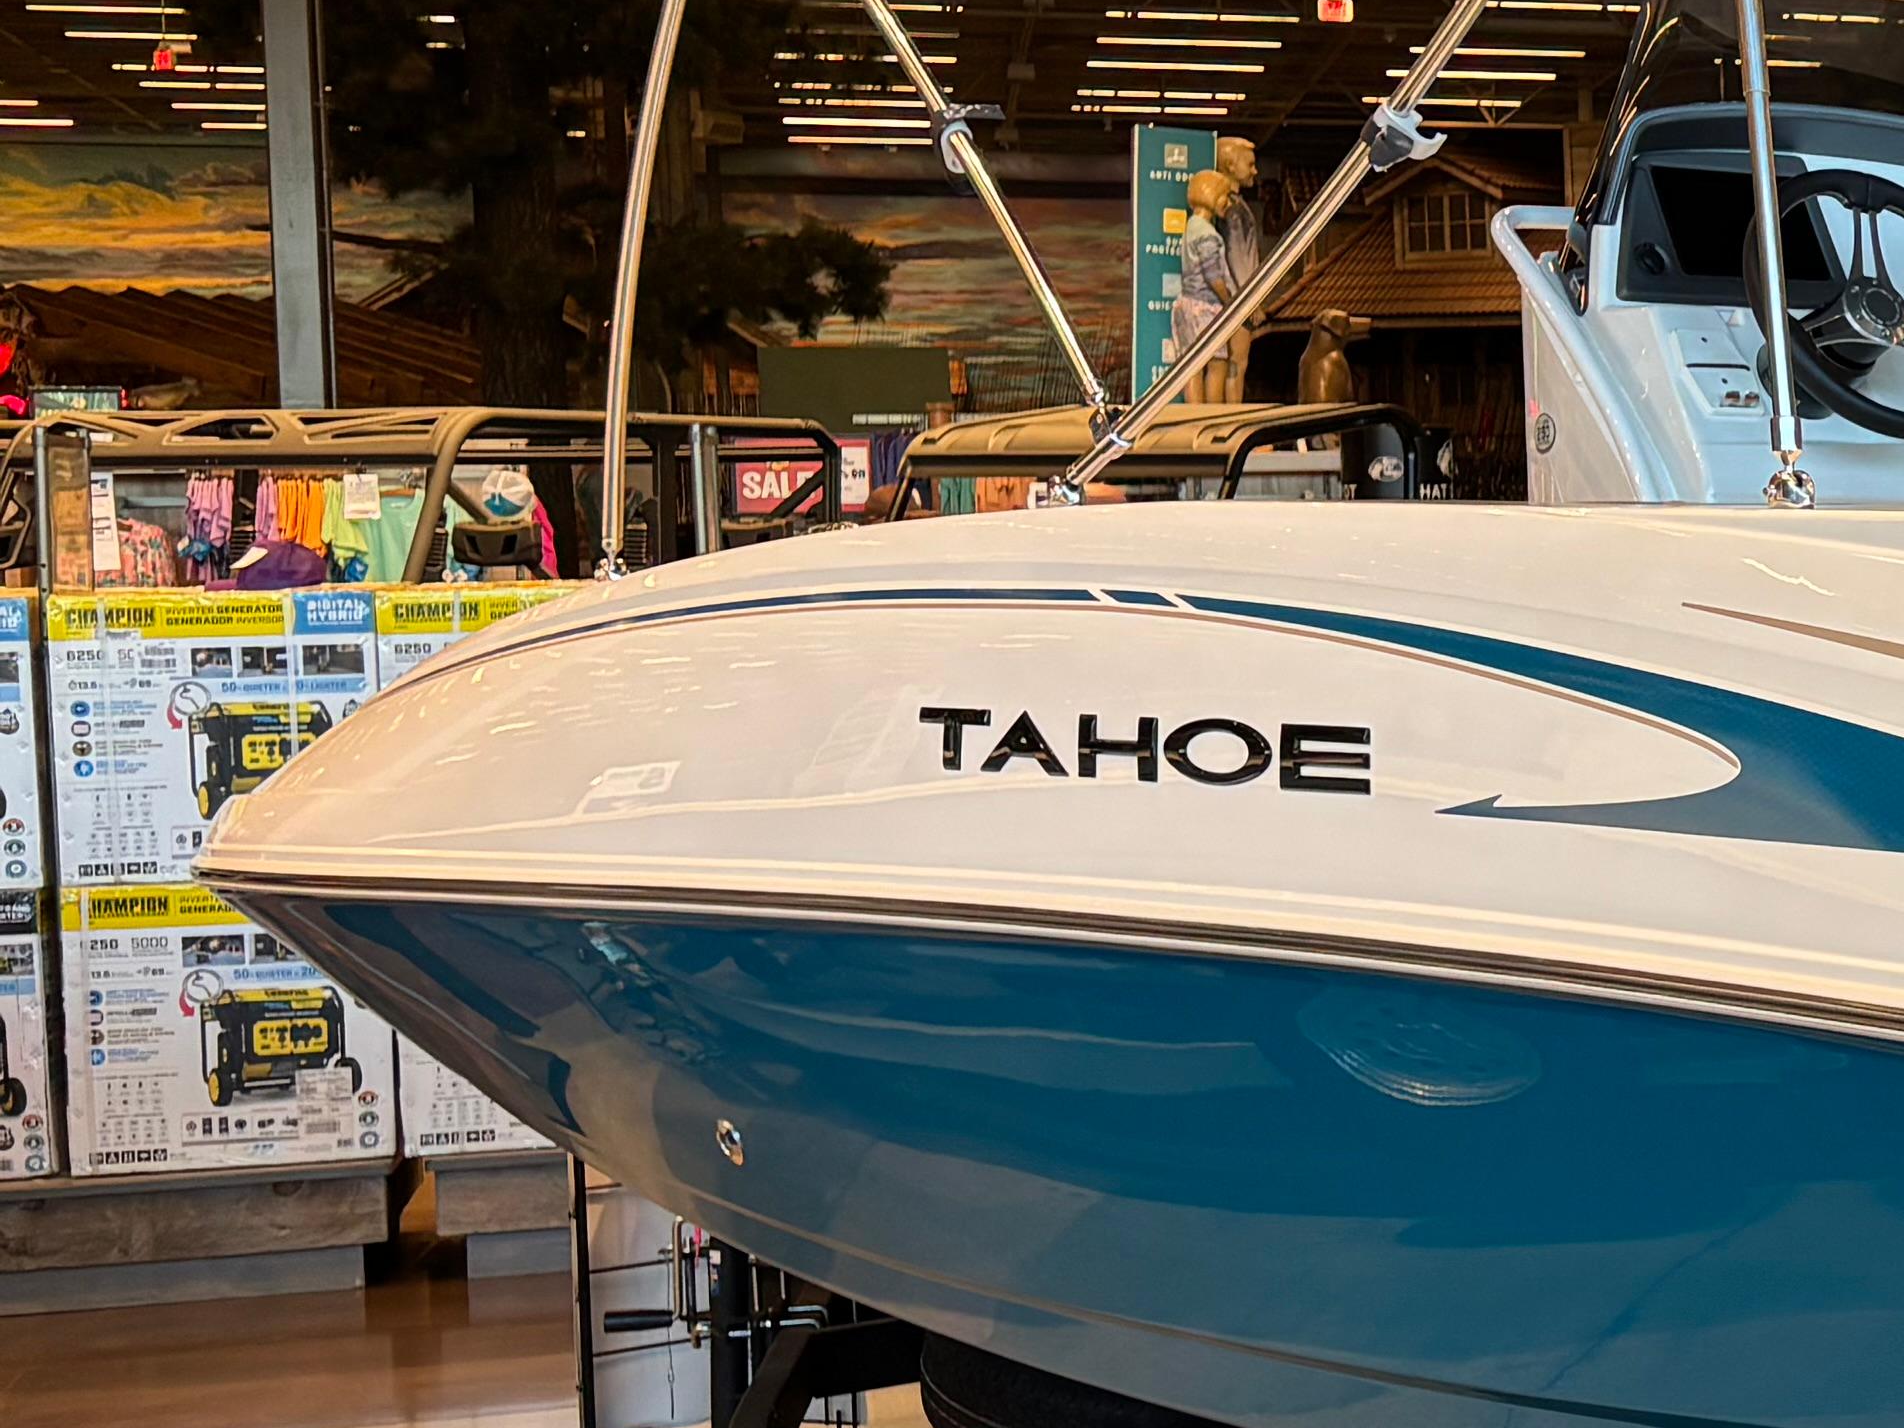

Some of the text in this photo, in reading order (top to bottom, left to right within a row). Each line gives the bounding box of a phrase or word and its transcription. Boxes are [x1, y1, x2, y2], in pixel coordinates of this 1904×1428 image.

[394, 602, 479, 621] CHAMPON
[919, 706, 1371, 796] TAHOE
[91, 895, 169, 916] HAMPION
[88, 938, 119, 951] 250
